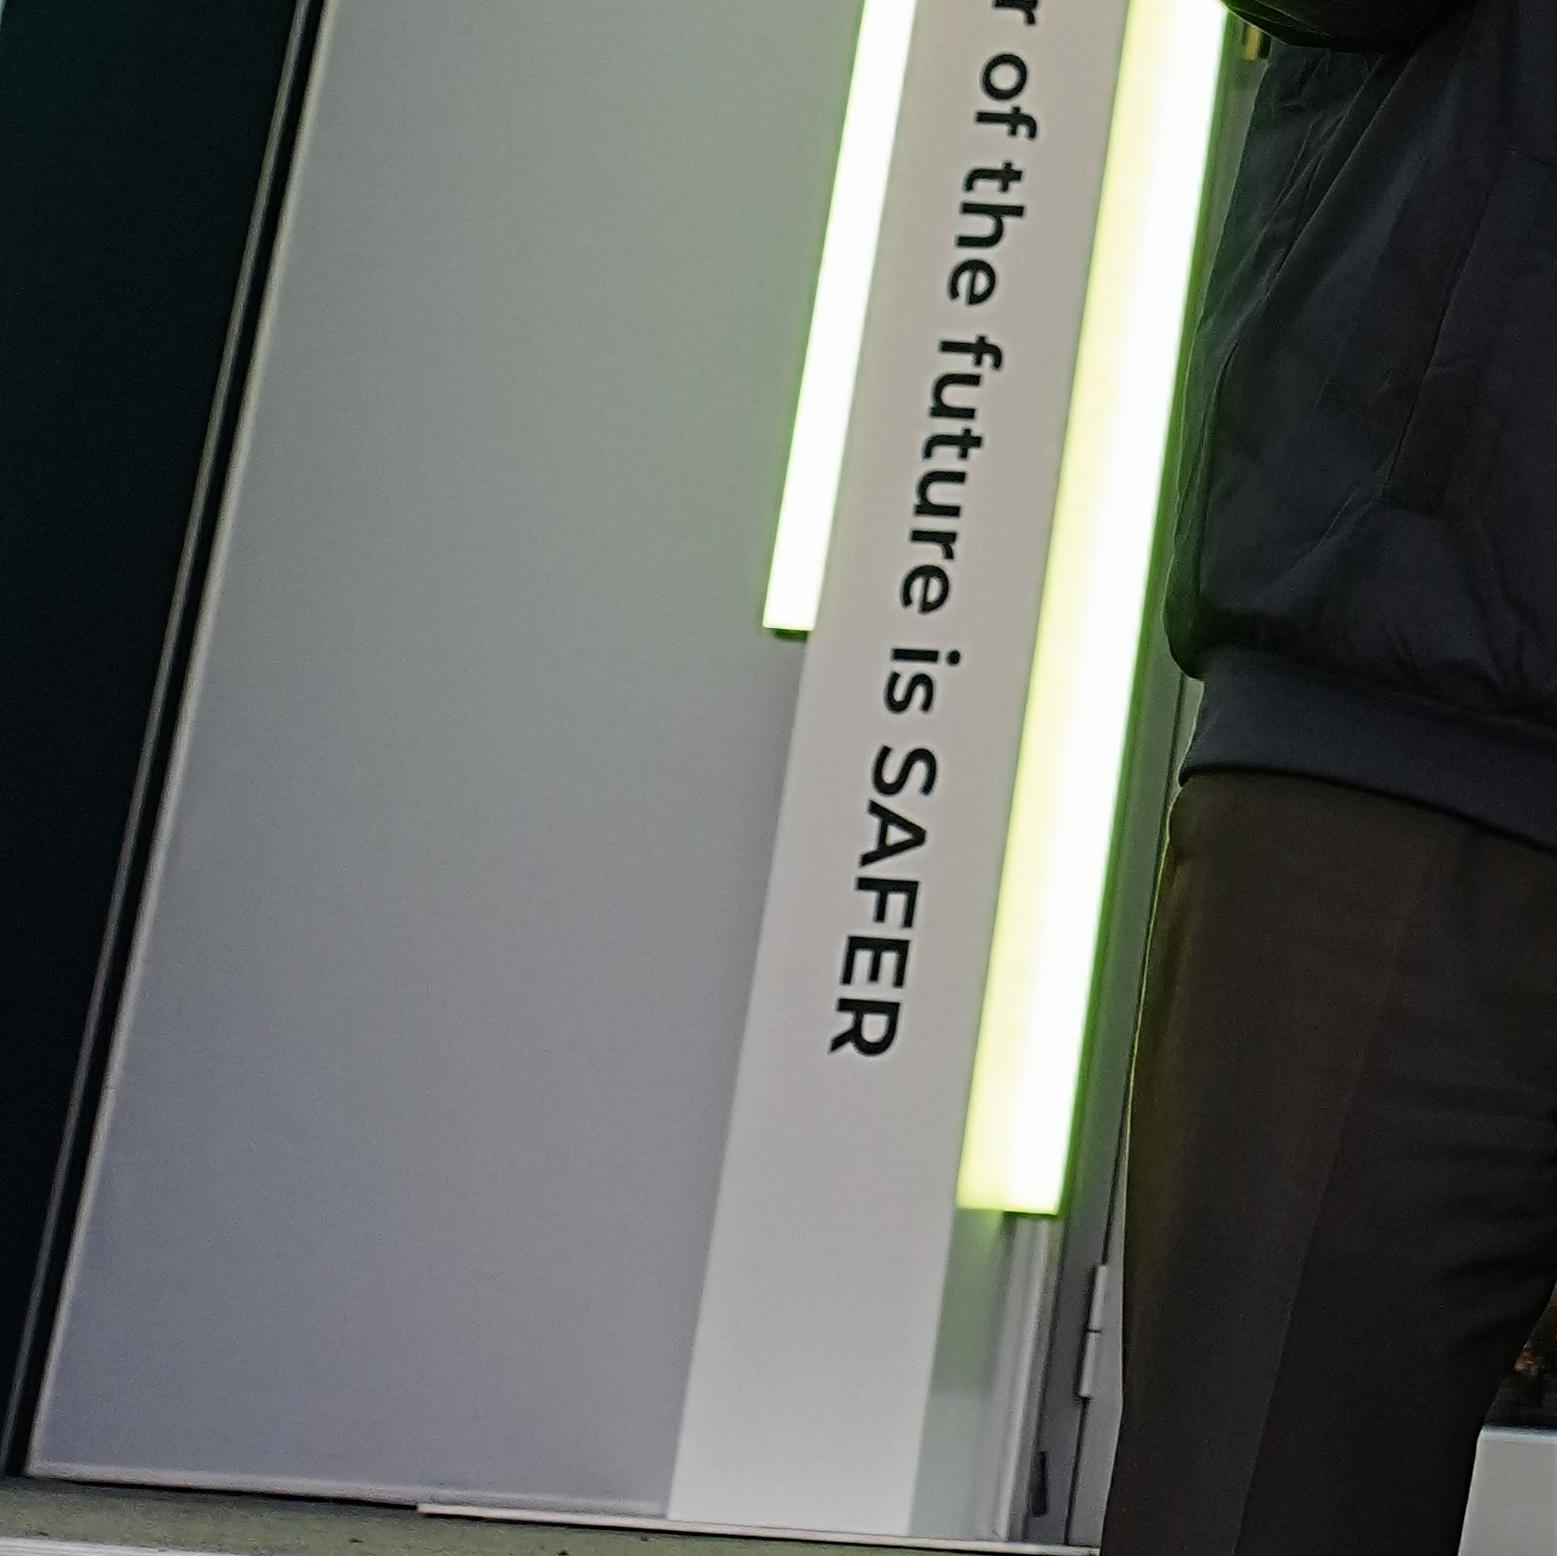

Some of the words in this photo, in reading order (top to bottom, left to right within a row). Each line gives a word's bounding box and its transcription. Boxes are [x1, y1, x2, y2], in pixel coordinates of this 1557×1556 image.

[975, 52, 1038, 141] of
[947, 160, 1025, 307] the
[899, 335, 1004, 615] future
[883, 646, 961, 716] is
[828, 744, 939, 1058] SAFER
